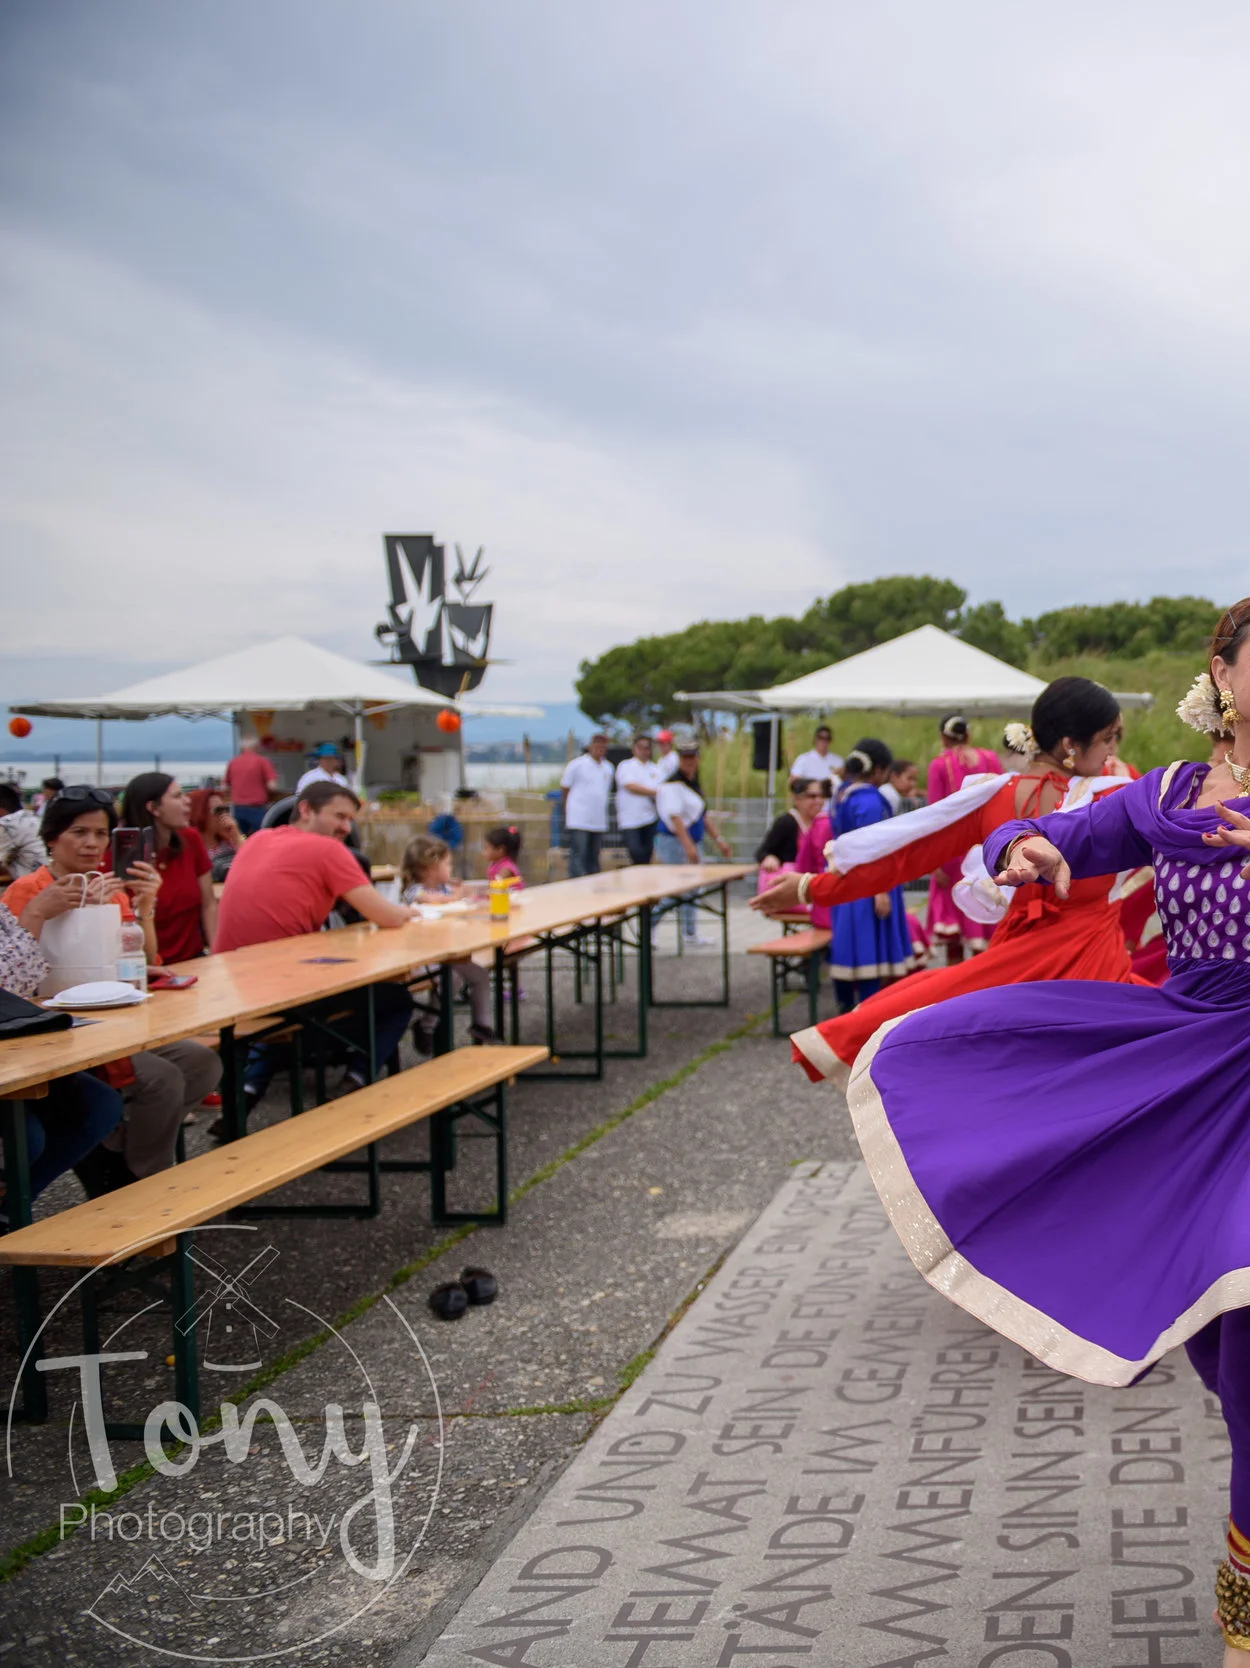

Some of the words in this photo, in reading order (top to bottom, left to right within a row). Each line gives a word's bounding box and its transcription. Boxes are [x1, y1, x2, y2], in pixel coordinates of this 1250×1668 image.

[753, 1225, 817, 1254] EIN
[674, 1263, 794, 1361] WASSER
[634, 1371, 722, 1417] ZU
[556, 1430, 687, 1527] UND
[1109, 1405, 1186, 1486] DEN
[601, 1472, 770, 1668] HEIMAT
[711, 1385, 805, 1456] SEIN
[760, 1329, 841, 1368] DIE
[715, 1493, 866, 1668] TÄNDE
[803, 1419, 892, 1476] IM
[996, 1450, 1085, 1551] SINN
[1111, 1506, 1198, 1668] HEUTE
